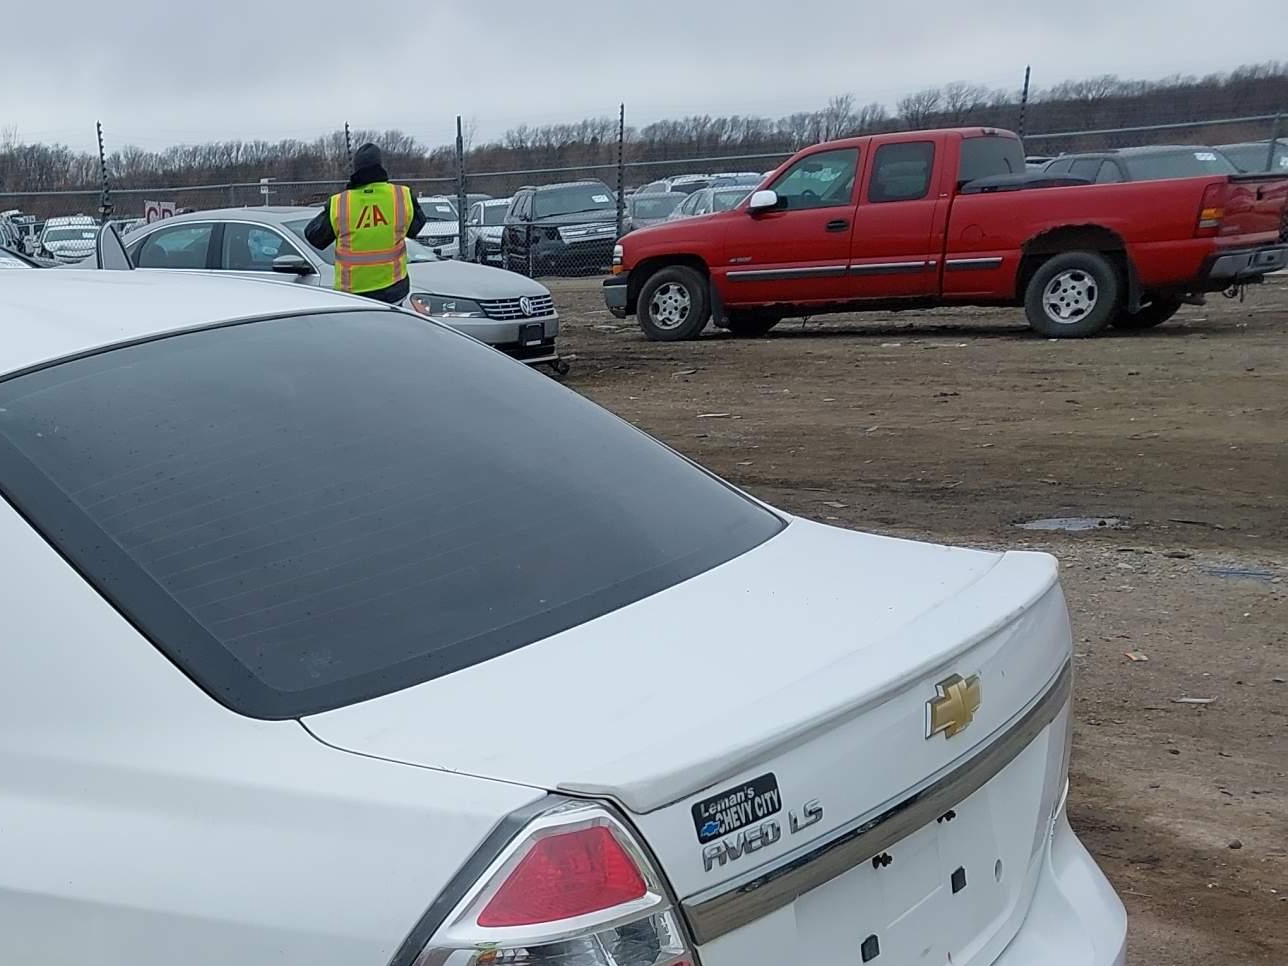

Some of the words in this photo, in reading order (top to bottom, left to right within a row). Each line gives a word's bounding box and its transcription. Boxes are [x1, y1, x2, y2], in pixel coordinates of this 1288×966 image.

[700, 785, 755, 818] Leman's
[715, 801, 753, 834] CHEVY
[755, 789, 779, 817] CITY
[702, 819, 782, 872] AVEO
[788, 798, 824, 835] LS
